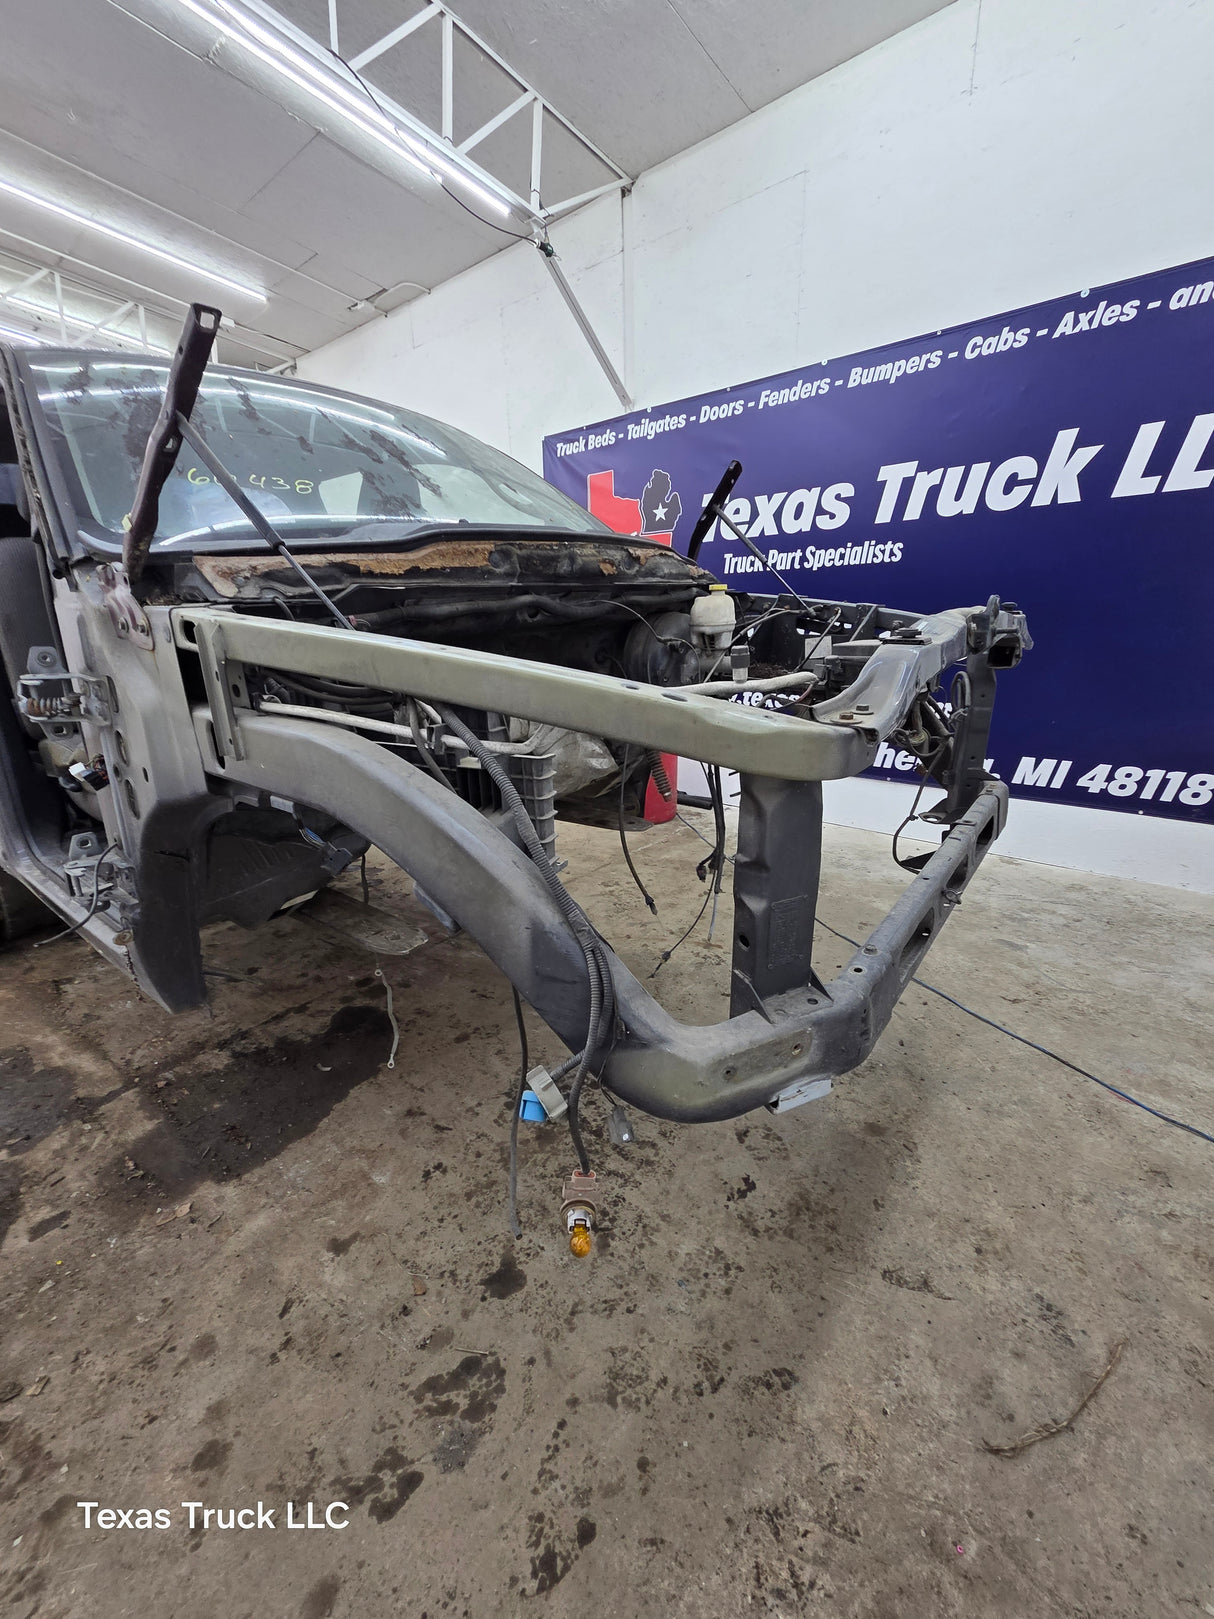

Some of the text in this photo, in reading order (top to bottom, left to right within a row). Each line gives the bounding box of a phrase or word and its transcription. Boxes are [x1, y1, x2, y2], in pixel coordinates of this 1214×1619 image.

[556, 435, 585, 457] Truck
[588, 428, 616, 450] Beds
[627, 413, 686, 440] Tailgates
[699, 399, 743, 423] Doors
[758, 377, 830, 409] Fenders
[847, 350, 942, 388] Bumpers
[965, 326, 1029, 360] Cabs
[1052, 299, 1141, 339] Axles
[1169, 281, 1214, 310] an
[874, 427, 1104, 524] Truck
[724, 540, 904, 574] Truck Part Specialists
[1011, 756, 1073, 789] MI
[1076, 763, 1214, 806] 48118
